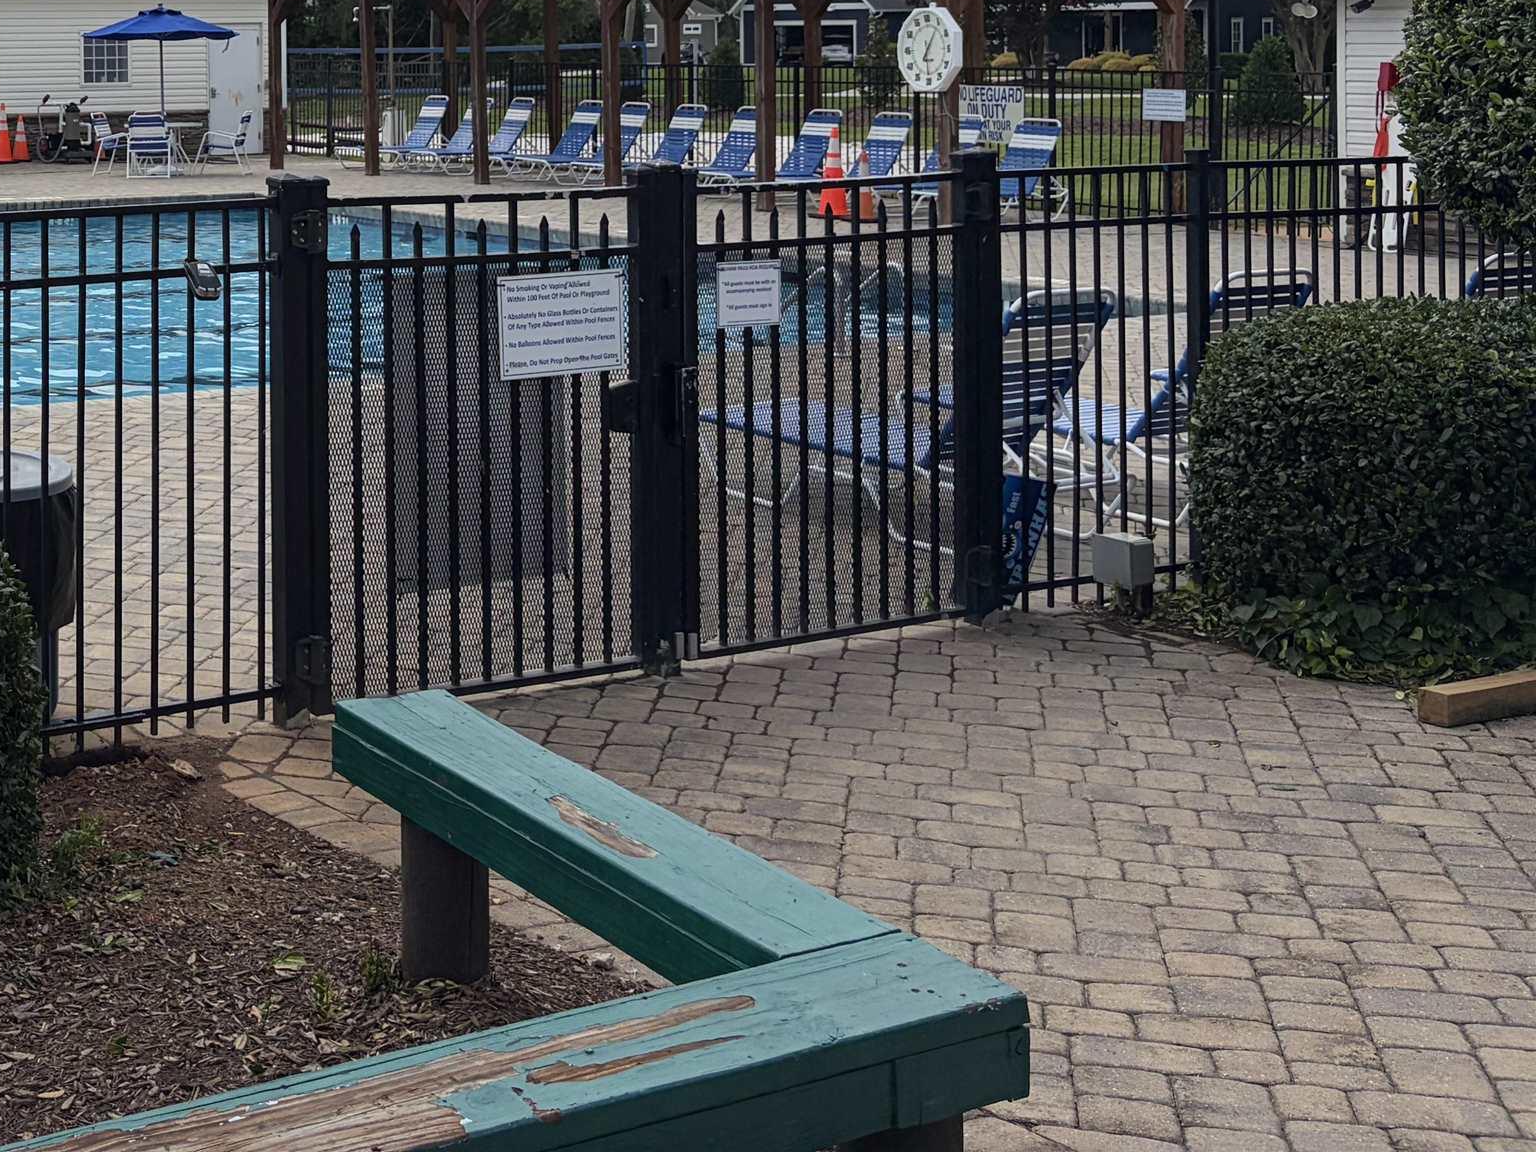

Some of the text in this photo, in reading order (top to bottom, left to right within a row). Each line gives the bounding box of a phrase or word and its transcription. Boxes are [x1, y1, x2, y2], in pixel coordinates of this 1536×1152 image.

[968, 86, 1023, 103] LIFEGUARD
[967, 102, 1007, 119] ON DUTY
[992, 119, 1011, 131] YOUR
[988, 130, 1003, 141] RISK
[516, 284, 540, 292] Smoking
[549, 282, 567, 290] Vaping
[568, 280, 590, 288] Allowed
[580, 289, 609, 298] Playground
[508, 311, 537, 320] Absolutely
[528, 321, 541, 329] Type
[518, 339, 541, 347] Balloons
